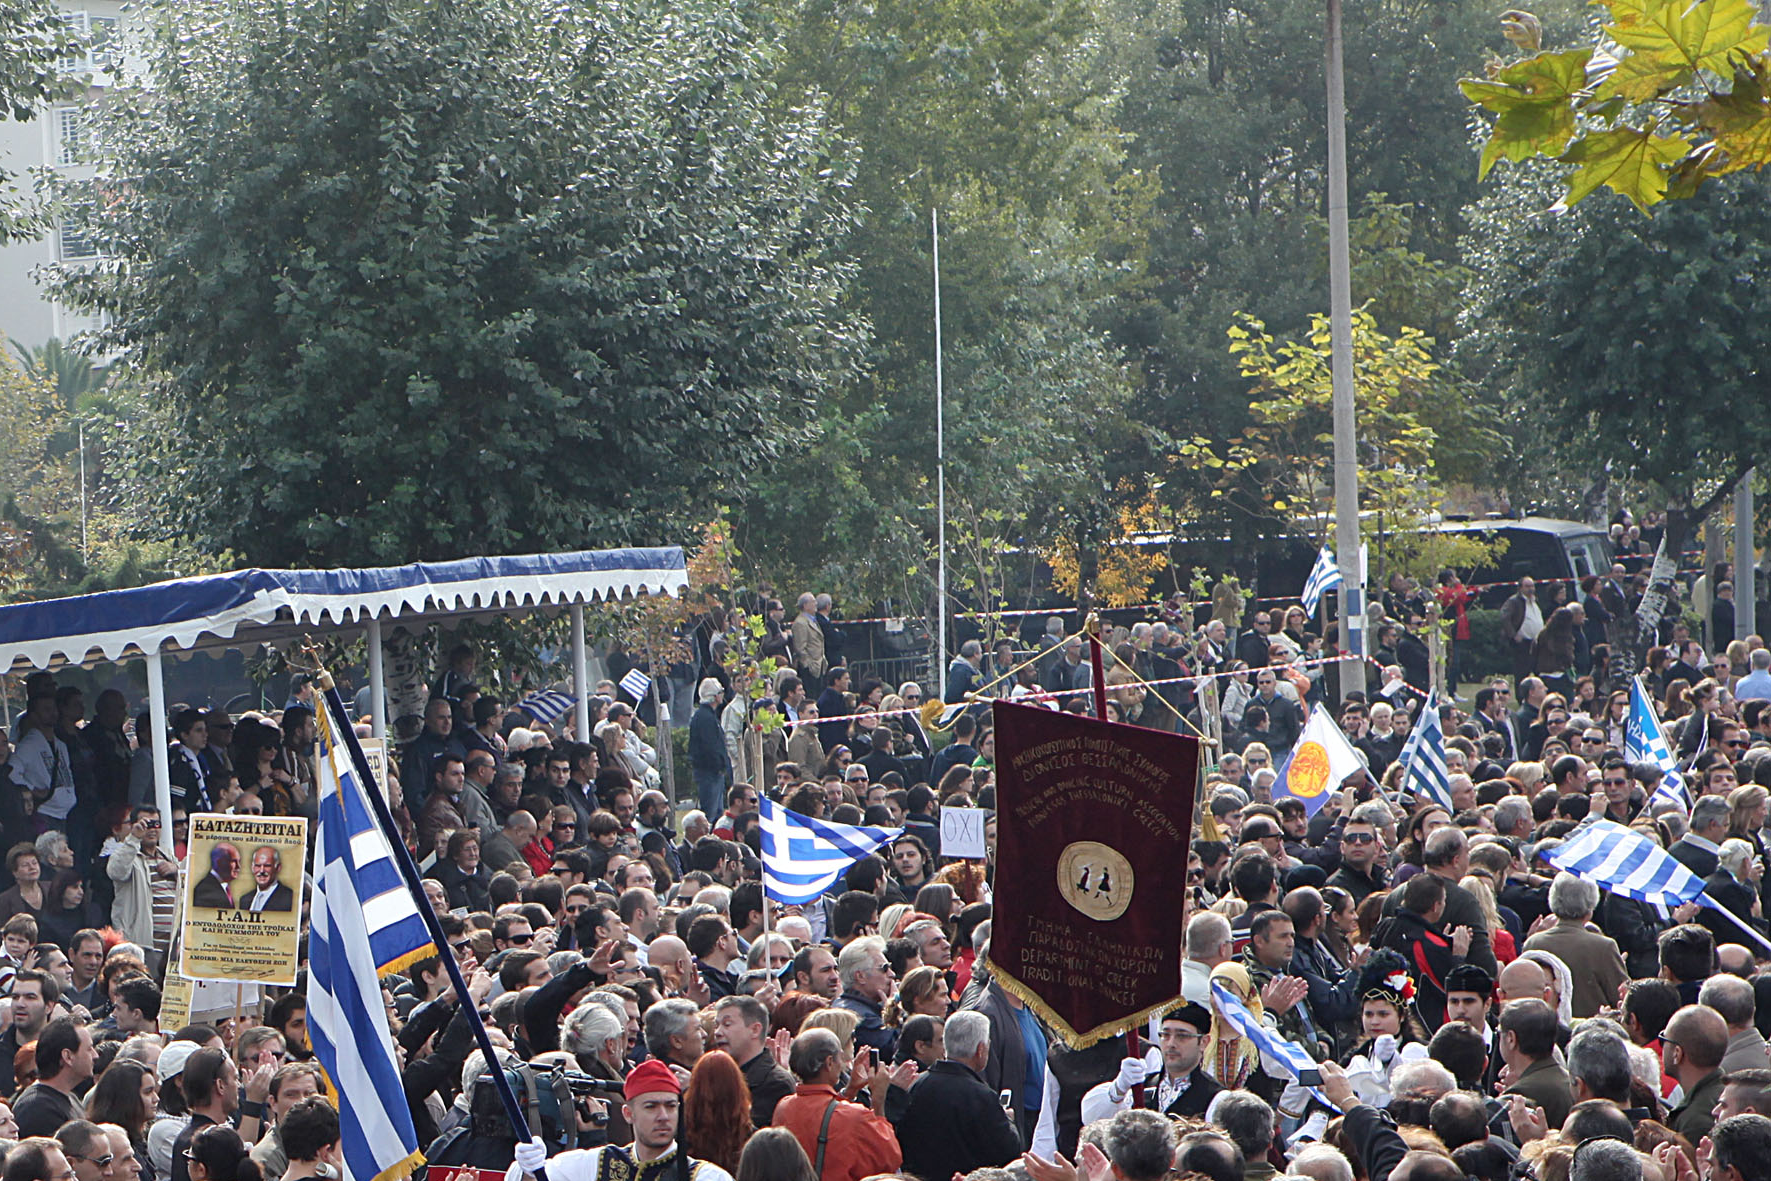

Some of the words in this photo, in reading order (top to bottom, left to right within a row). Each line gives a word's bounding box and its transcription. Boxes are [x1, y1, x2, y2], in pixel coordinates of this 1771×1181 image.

[1022, 753, 1076, 782] ΔΙΟΝΥΣΟΣ
[1081, 752, 1163, 794] ΘΕΣΣΑΛΟΝΙΚΗΣ
[195, 819, 302, 836] ΚΑΤΑΖΗΤΕΙΤΑΙ
[944, 812, 979, 843] ΟΧΙ
[1137, 799, 1181, 840] ASSOCIATION
[192, 921, 246, 930] ΕΝΤΟΛΟΔΟΧΟΣ
[216, 910, 266, 923] Γ.Α.Π.
[224, 928, 265, 936] ΣΥΜΜΟΡΙΑ
[1028, 915, 1071, 936] ΤΜΗΜΑ
[1088, 932, 1164, 960] ΕΛΛΗΝΙΚΩΝ
[1021, 947, 1089, 970] DEPARTMENT
[1029, 931, 1111, 966] ΠΑΡΑΔΟΣΙΑΚΩΝ
[1110, 957, 1158, 974] ΧΟΡΩΝ
[1022, 966, 1094, 990] TRADITIONAL
